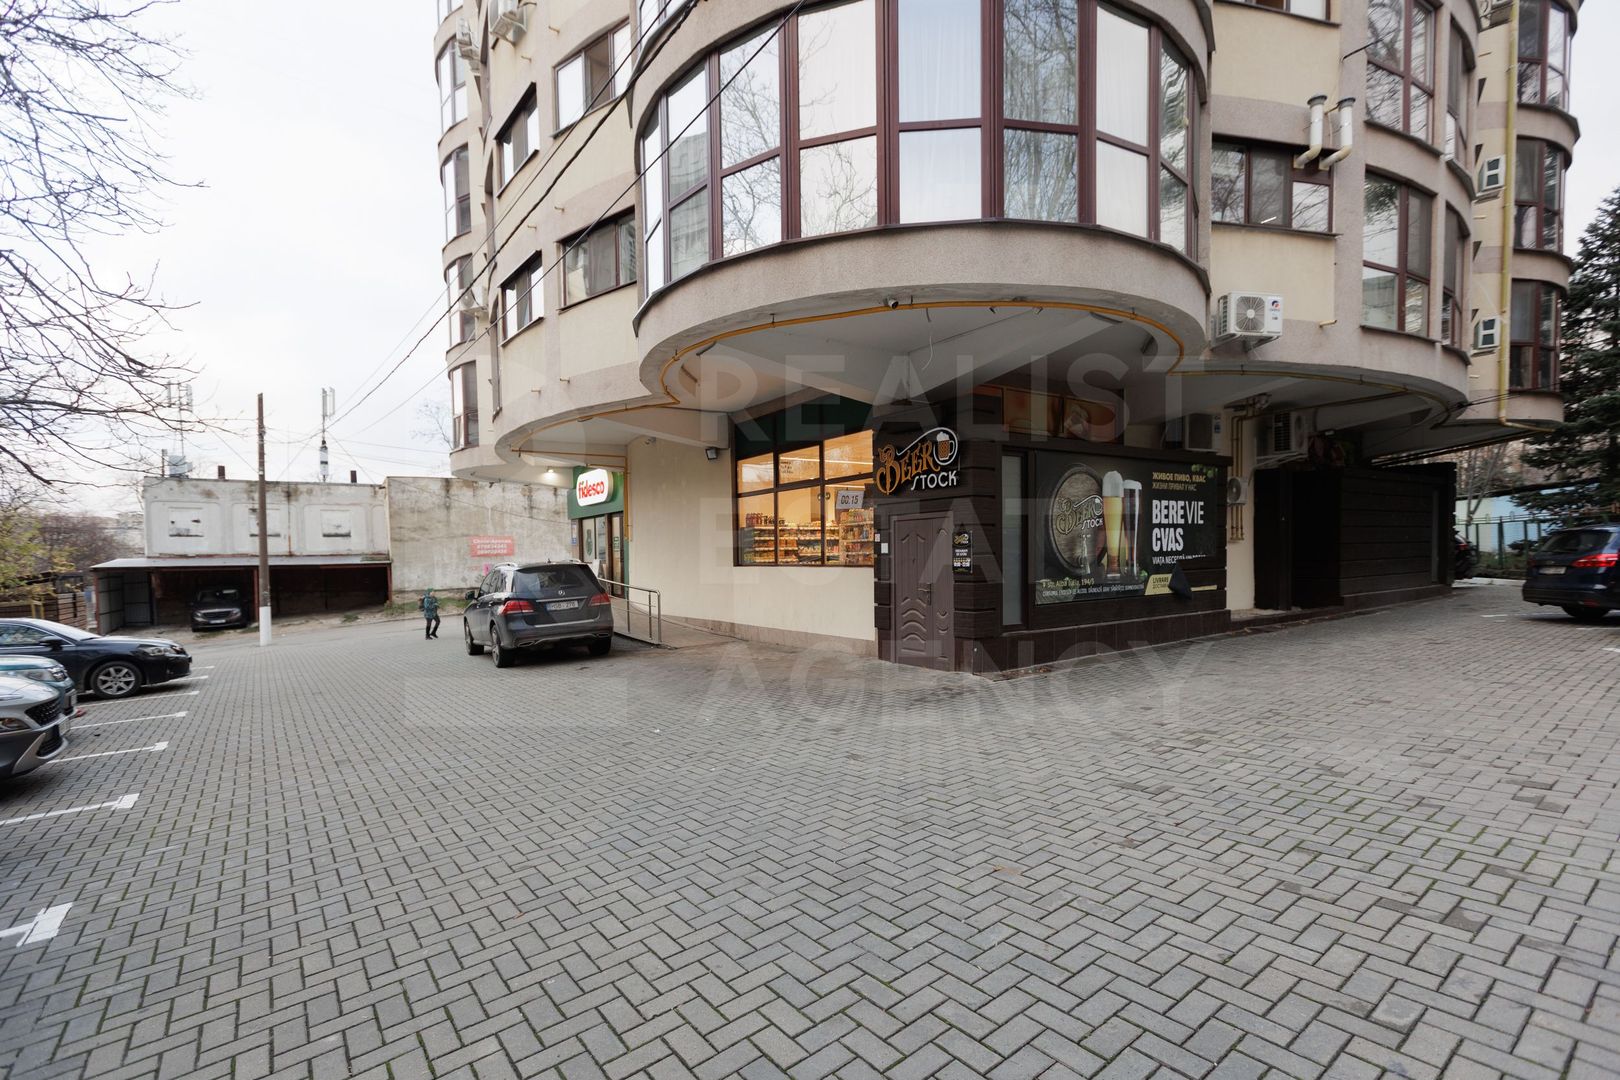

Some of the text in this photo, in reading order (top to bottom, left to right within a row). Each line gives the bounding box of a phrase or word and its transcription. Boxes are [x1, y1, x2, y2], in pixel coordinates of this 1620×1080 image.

[875, 440, 941, 496] BEER
[910, 470, 958, 491] STOCK
[578, 479, 605, 499] fidesco
[1152, 499, 1204, 524] BERE VIE
[1152, 527, 1184, 552] CVAS
